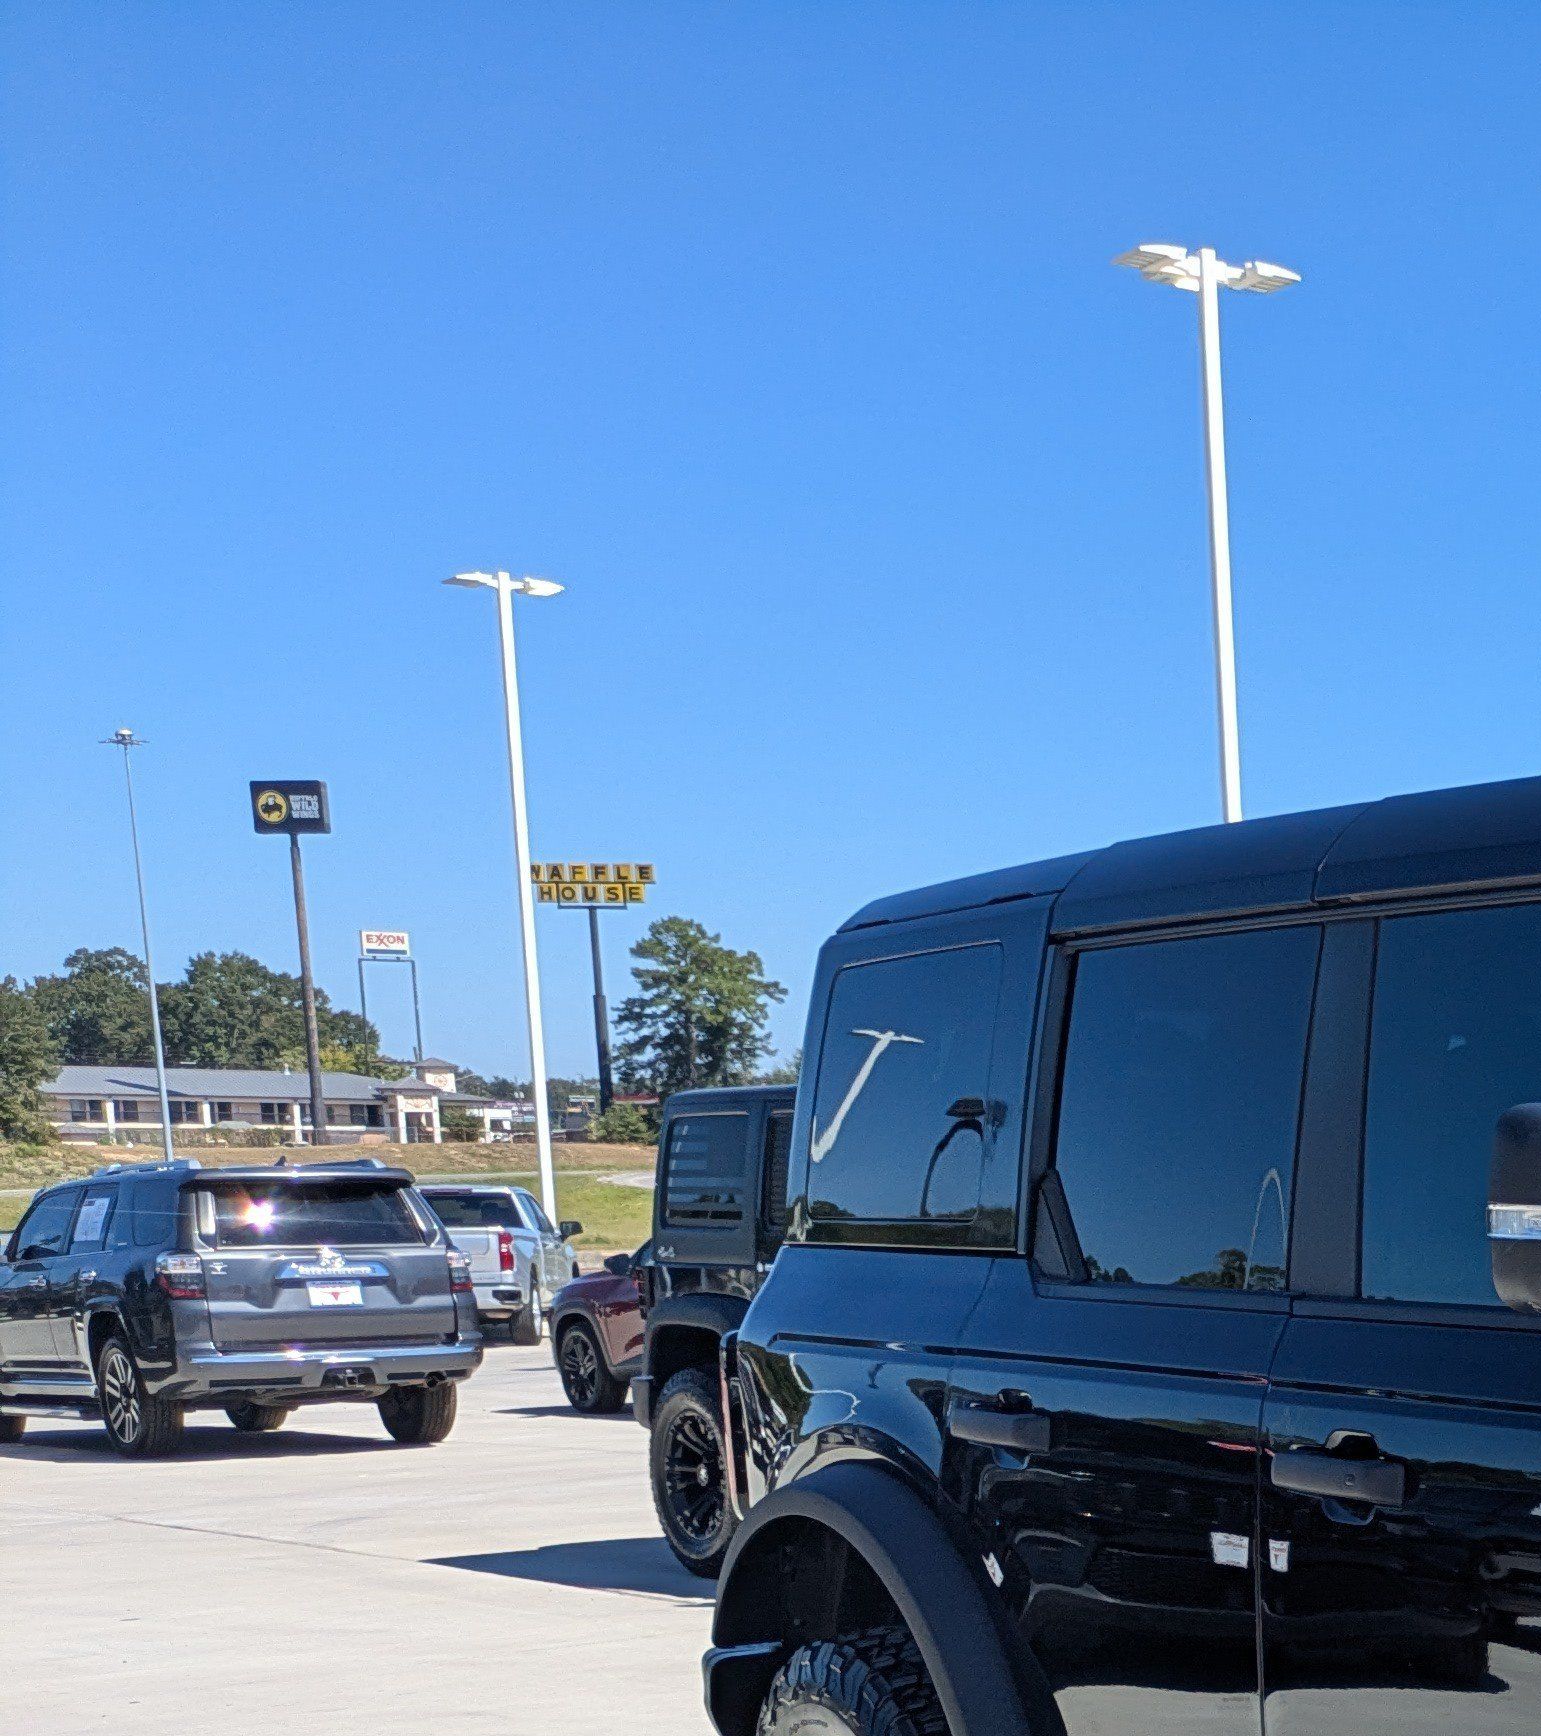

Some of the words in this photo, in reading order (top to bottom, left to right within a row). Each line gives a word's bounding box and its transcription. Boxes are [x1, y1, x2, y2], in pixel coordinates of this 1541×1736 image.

[291, 801, 319, 811] WILD
[539, 885, 642, 901] HOUSE
[365, 933, 405, 948] EXXON
